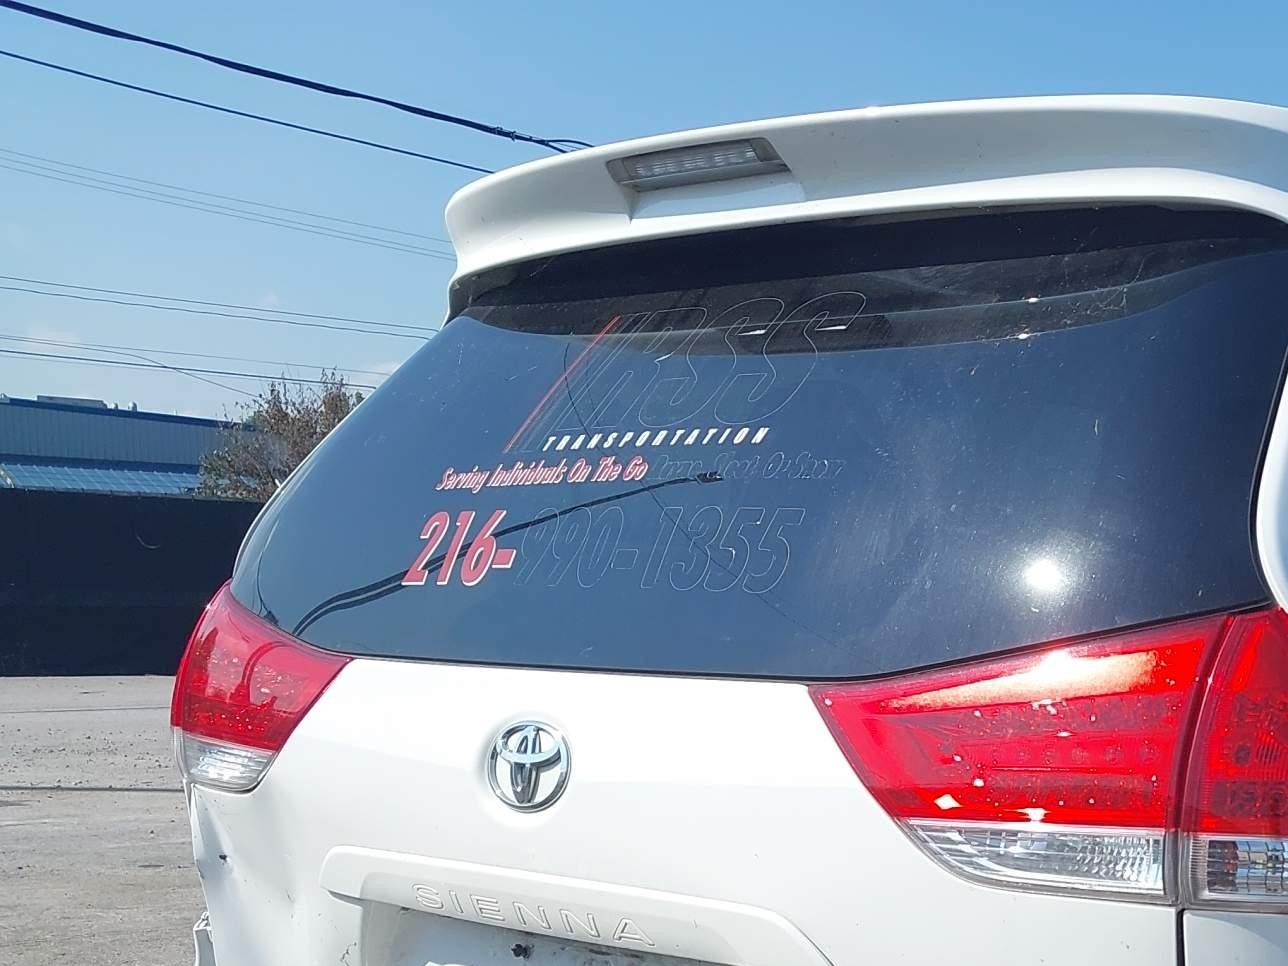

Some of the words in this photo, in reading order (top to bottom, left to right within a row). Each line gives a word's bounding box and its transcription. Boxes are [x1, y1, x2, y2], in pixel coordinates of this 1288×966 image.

[543, 427, 770, 451] TRANSPORTATION
[435, 466, 490, 494] Serving
[486, 458, 567, 487] Individuals
[567, 458, 592, 483] On
[590, 456, 622, 482] The
[623, 456, 648, 480] Go
[413, 884, 655, 947] SIENNA
